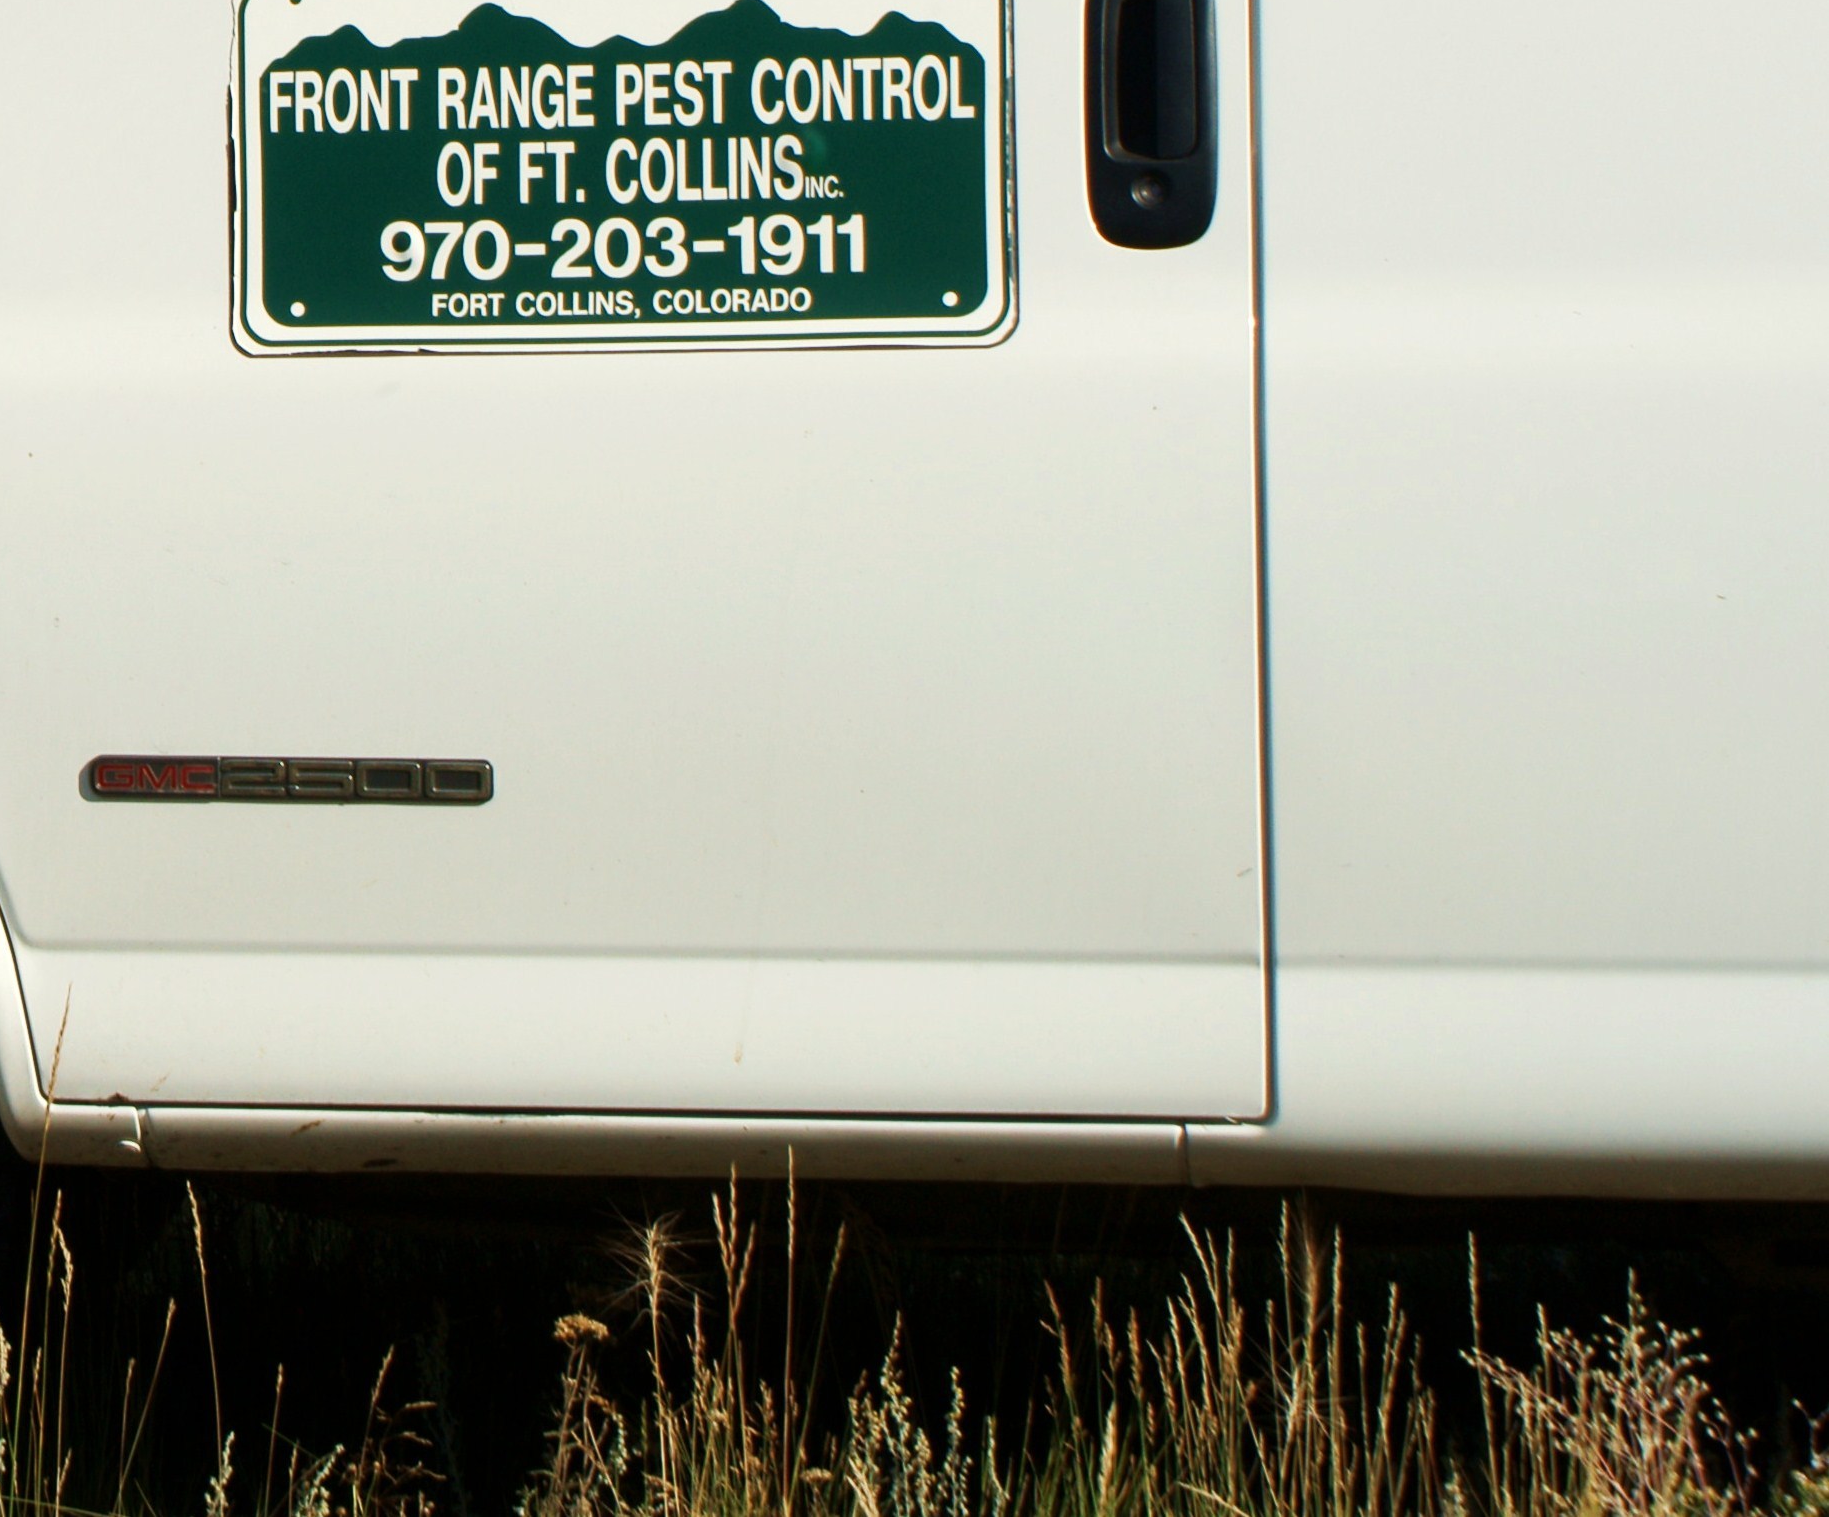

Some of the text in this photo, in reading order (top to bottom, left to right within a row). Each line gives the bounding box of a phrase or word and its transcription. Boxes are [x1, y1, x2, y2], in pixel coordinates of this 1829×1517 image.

[270, 55, 976, 134] FRONT RANGE PEST CONTROL
[437, 135, 845, 207] OF FT. COLLINS INC.
[380, 213, 866, 282] 970-203-1911
[433, 286, 813, 319] FORT COLLINS, COLORADO
[96, 758, 493, 800] GMC 2500
